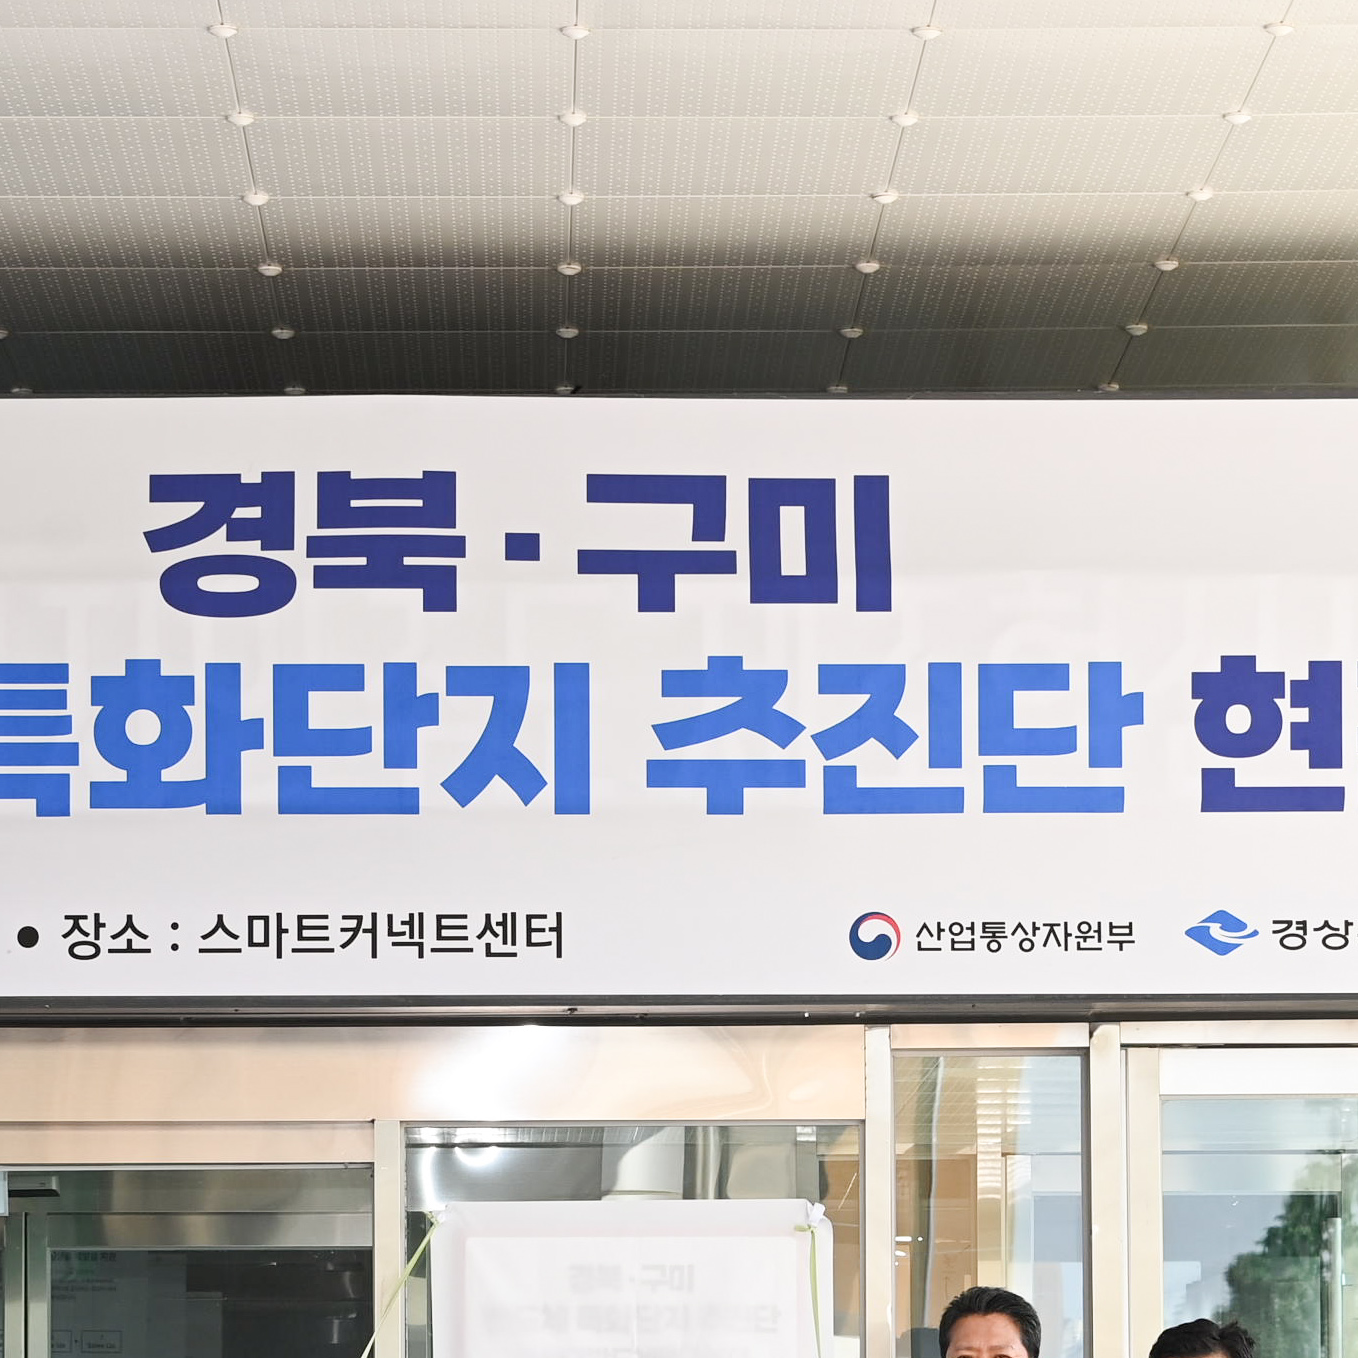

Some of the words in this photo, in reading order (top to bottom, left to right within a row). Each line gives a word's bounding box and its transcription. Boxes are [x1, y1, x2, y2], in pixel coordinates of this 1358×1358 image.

[647, 656, 1143, 814] 추진단
[62, 913, 151, 960] 장소
[199, 912, 562, 958] 스마트커넥트센터
[916, 921, 1135, 952] 산업통상자원부
